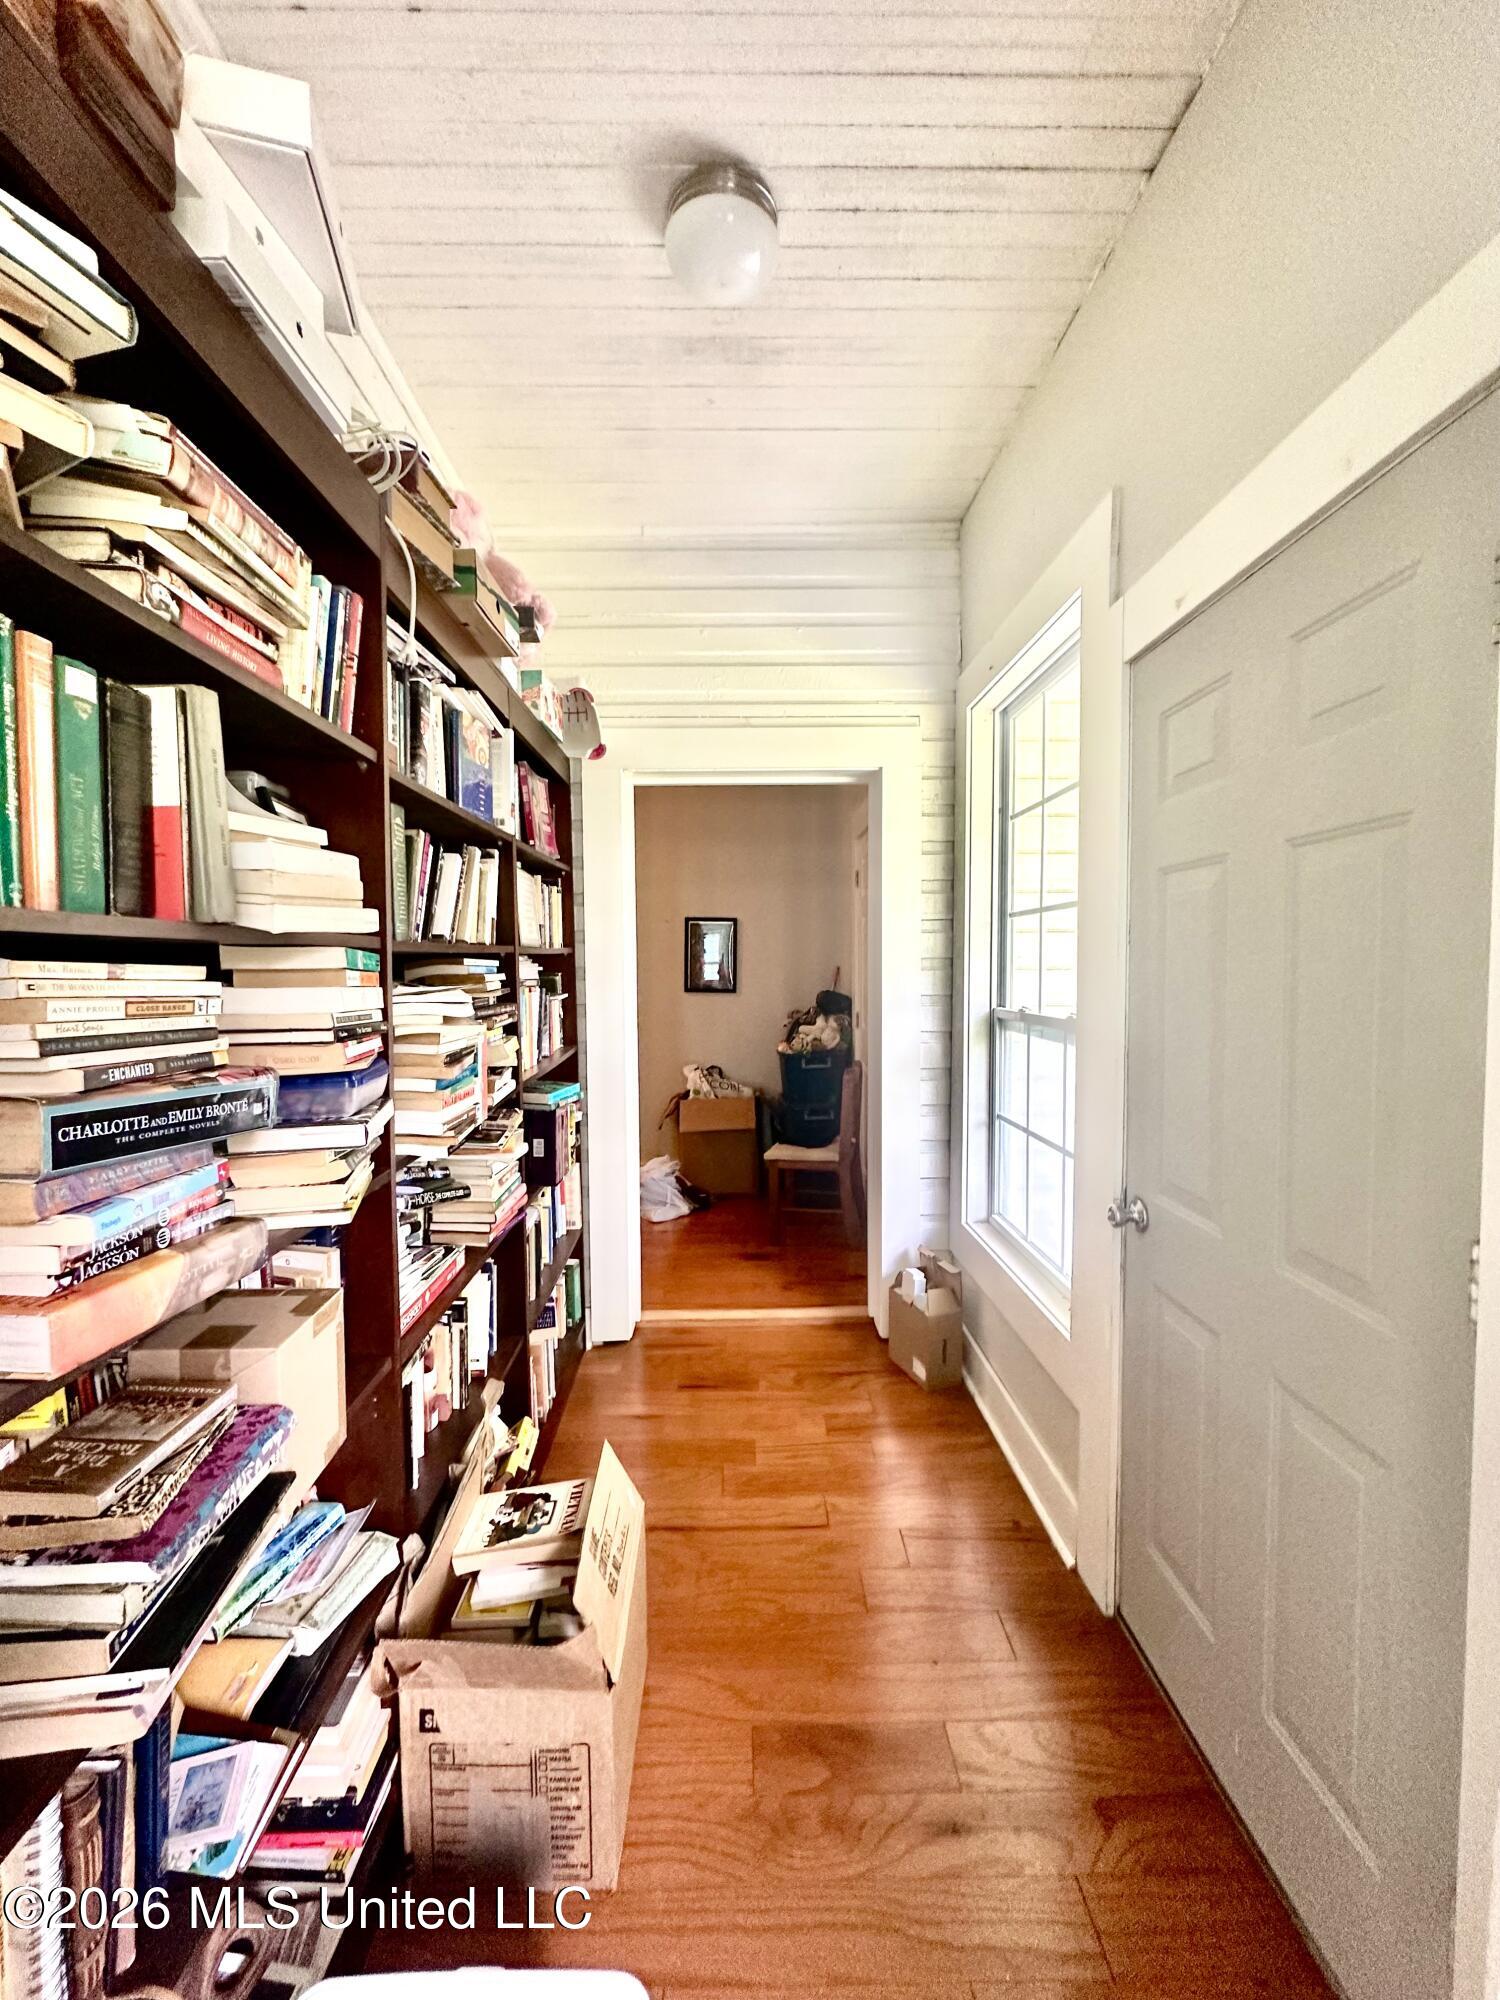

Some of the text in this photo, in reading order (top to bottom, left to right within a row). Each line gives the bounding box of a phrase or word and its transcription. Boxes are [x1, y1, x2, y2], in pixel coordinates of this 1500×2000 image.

[206, 631, 257, 673] LIVING HISTORY
[135, 1003, 187, 1012] CLOSE RANGE
[56, 1022, 104, 1035] Heart Songs
[109, 1062, 155, 1082] ENCHANTED
[57, 1115, 149, 1143] CHARLOTTE
[151, 1117, 168, 1128] AND
[168, 1106, 205, 1124] EMILY
[115, 1119, 221, 1145] THE COMPLETE NOVELS
[414, 1191, 435, 1206] HORSE
[86, 1225, 145, 1262] JACKSON
[74, 1247, 140, 1285] JACKSON
[50, 1440, 143, 1456] Two Cities
[41, 1452, 113, 1469] Tale of
